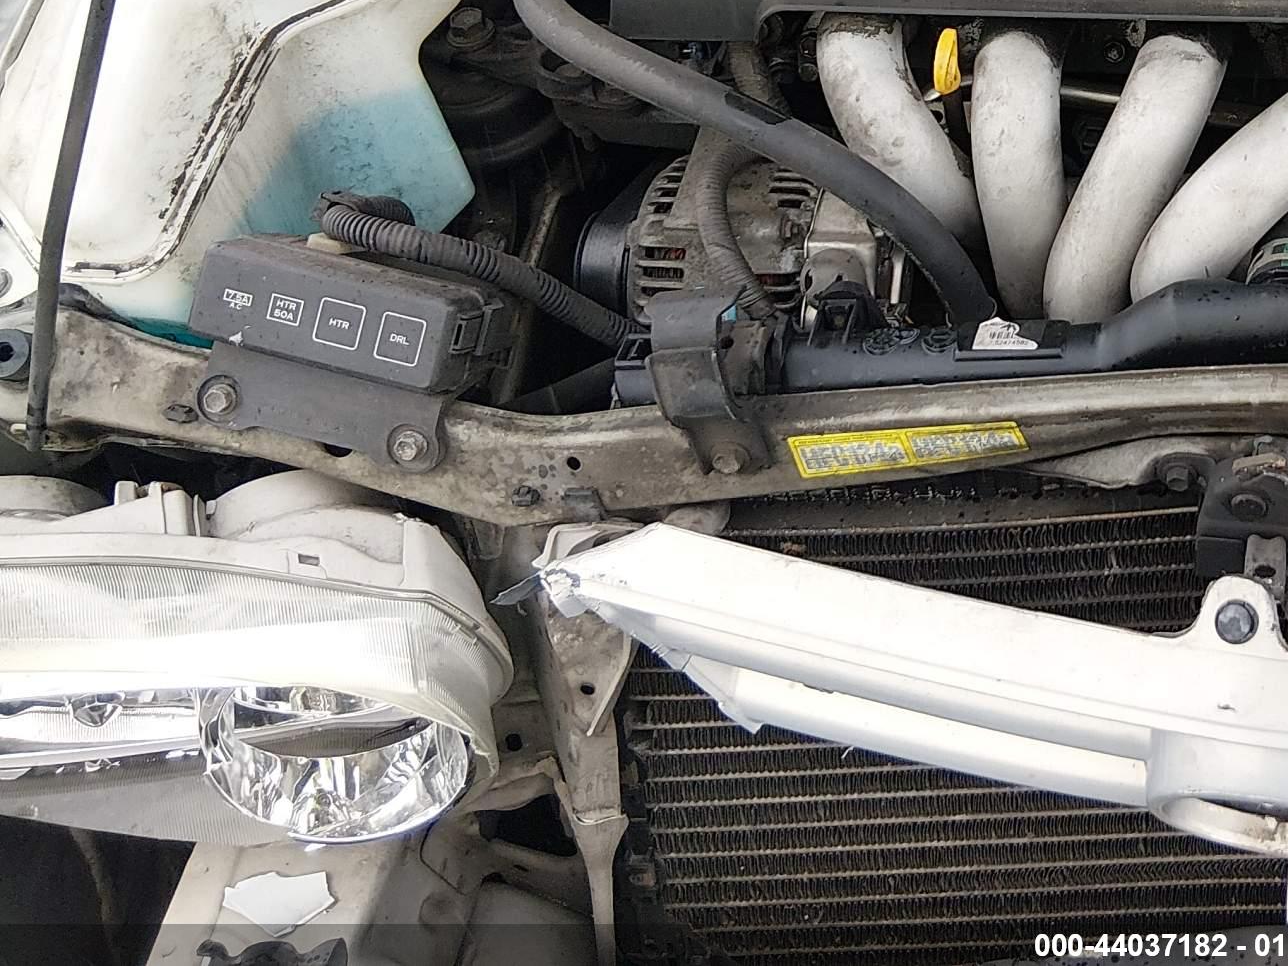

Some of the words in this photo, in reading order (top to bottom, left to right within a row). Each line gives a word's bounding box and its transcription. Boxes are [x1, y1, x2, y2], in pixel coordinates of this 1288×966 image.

[276, 299, 297, 311] HTR
[274, 309, 294, 321] 50A
[328, 317, 350, 330] HTR
[389, 333, 410, 346] DRL
